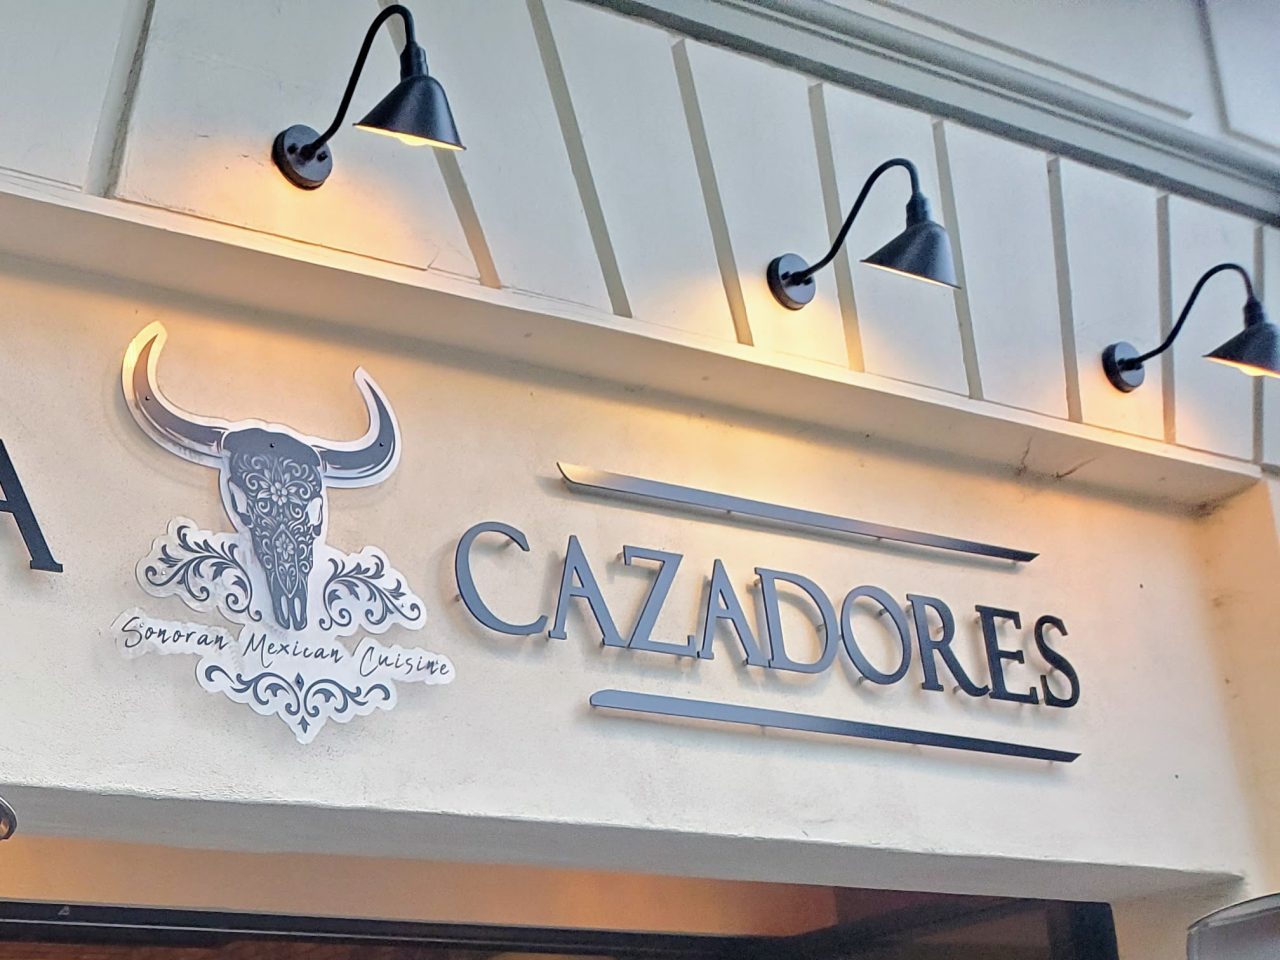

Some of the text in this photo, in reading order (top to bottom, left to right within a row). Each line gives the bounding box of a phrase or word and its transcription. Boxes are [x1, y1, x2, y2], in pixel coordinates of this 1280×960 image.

[121, 616, 450, 677] Sonoran Mexican Cuisine
[455, 521, 1081, 708] CAZADORES
